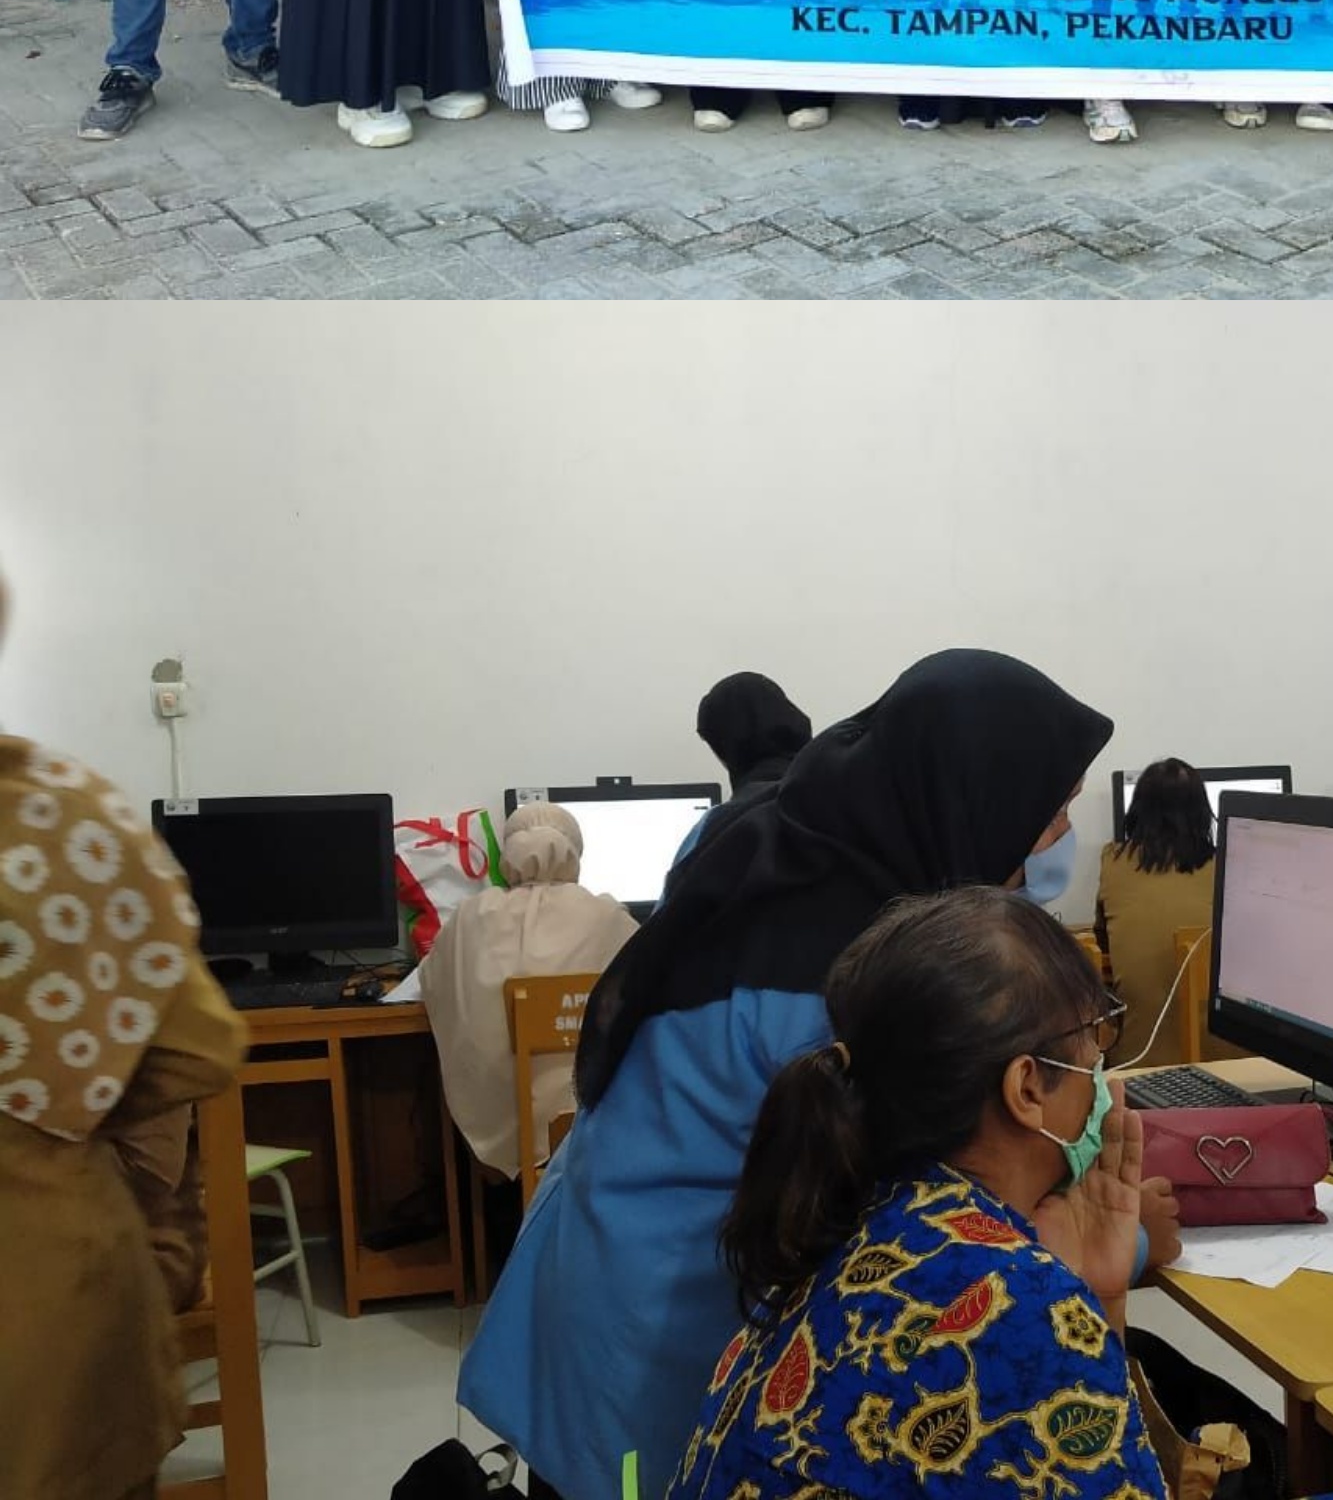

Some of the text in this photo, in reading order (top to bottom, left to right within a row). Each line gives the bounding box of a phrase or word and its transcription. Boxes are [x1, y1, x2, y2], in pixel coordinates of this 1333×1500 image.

[791, 6, 1293, 41] KEC. TAMPAN, PEKANBARU
